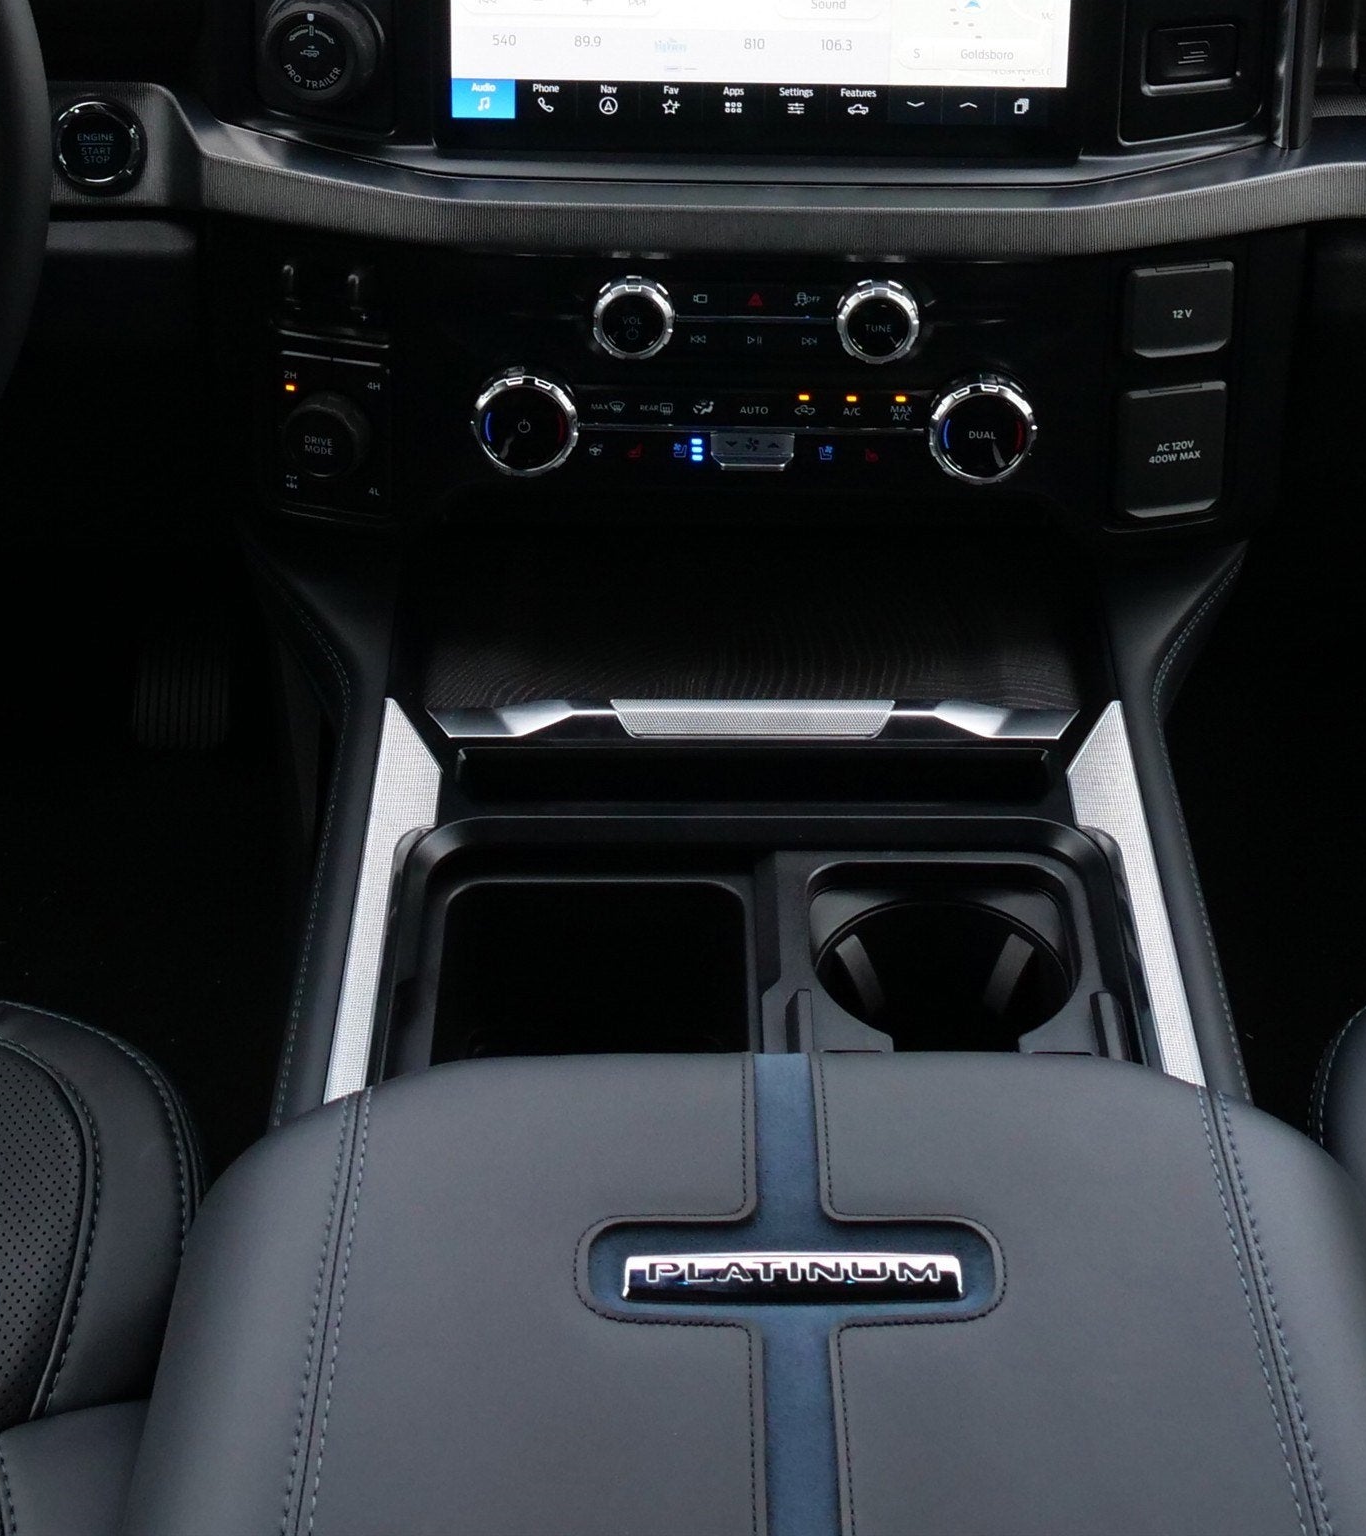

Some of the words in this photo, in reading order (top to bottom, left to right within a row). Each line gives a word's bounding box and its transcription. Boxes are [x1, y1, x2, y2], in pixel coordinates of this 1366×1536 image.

[492, 34, 517, 47] 540
[574, 35, 602, 48] 89.9
[743, 38, 765, 50] 810
[820, 39, 853, 52] 106.3
[913, 48, 920, 59] S
[960, 49, 1014, 61] Goldsboro
[283, 63, 302, 84] PRO
[305, 66, 342, 90] TRAILER
[471, 82, 496, 92] Audio
[533, 83, 559, 94] Phone
[600, 85, 617, 94] Nav
[663, 86, 679, 95] Fav
[723, 86, 745, 97] Apps
[779, 87, 814, 98] Settings
[840, 88, 876, 98] Features
[76, 133, 115, 142] ENGINE
[81, 147, 111, 156] START
[83, 155, 110, 165] STOP
[806, 295, 821, 304] OFF
[1172, 308, 1182, 320] 12
[1183, 308, 1193, 320] V
[622, 316, 642, 326] VOL
[865, 324, 892, 334] TUNE
[283, 370, 298, 380] 2H
[367, 381, 381, 391] 4H
[591, 402, 609, 411] MAX
[640, 403, 660, 412] REAR
[739, 406, 769, 415] AUTO
[843, 406, 861, 417] A/C
[890, 405, 913, 415] MAX
[892, 412, 911, 423] A/C
[968, 430, 996, 440] DUAL
[304, 435, 333, 446] DRIVE
[304, 444, 333, 456] MODE
[1157, 442, 1168, 453] AC
[1169, 439, 1195, 451] 120V
[1148, 454, 1178, 464] 400W
[1180, 450, 1201, 461] MAX
[368, 486, 380, 496] 4L
[645, 1261, 941, 1283] PLATINUM
